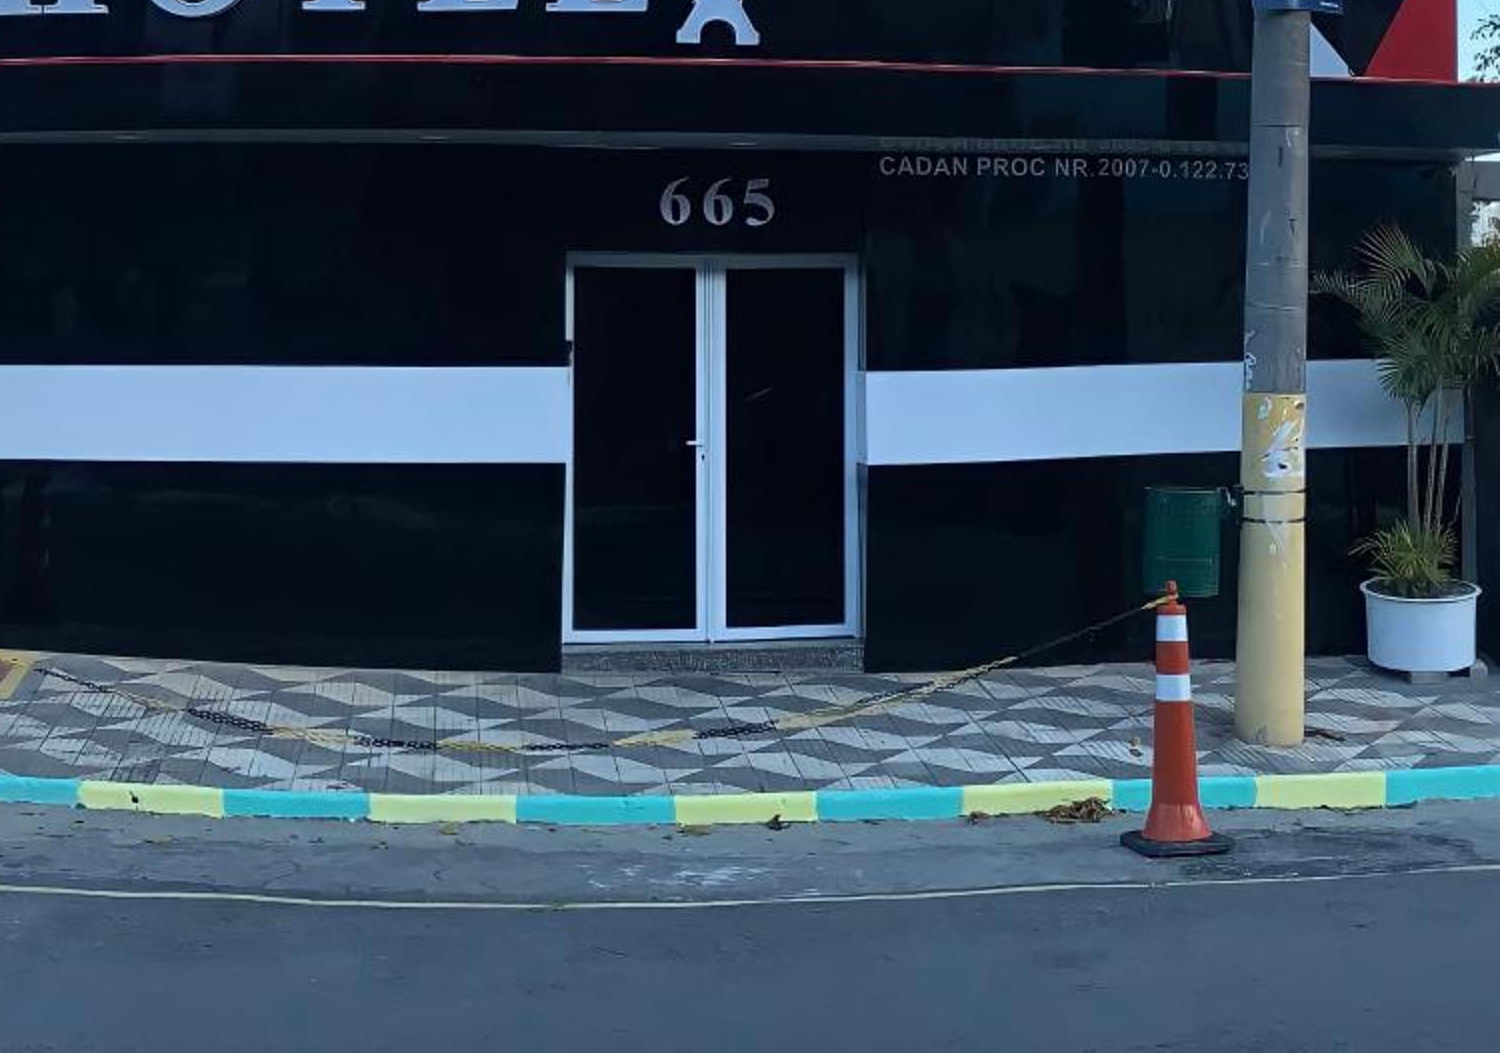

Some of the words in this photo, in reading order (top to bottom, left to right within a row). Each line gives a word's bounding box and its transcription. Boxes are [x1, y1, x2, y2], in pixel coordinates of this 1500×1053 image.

[879, 155, 968, 177] CADAN
[977, 156, 1045, 177] PROC
[660, 176, 776, 226] 665
